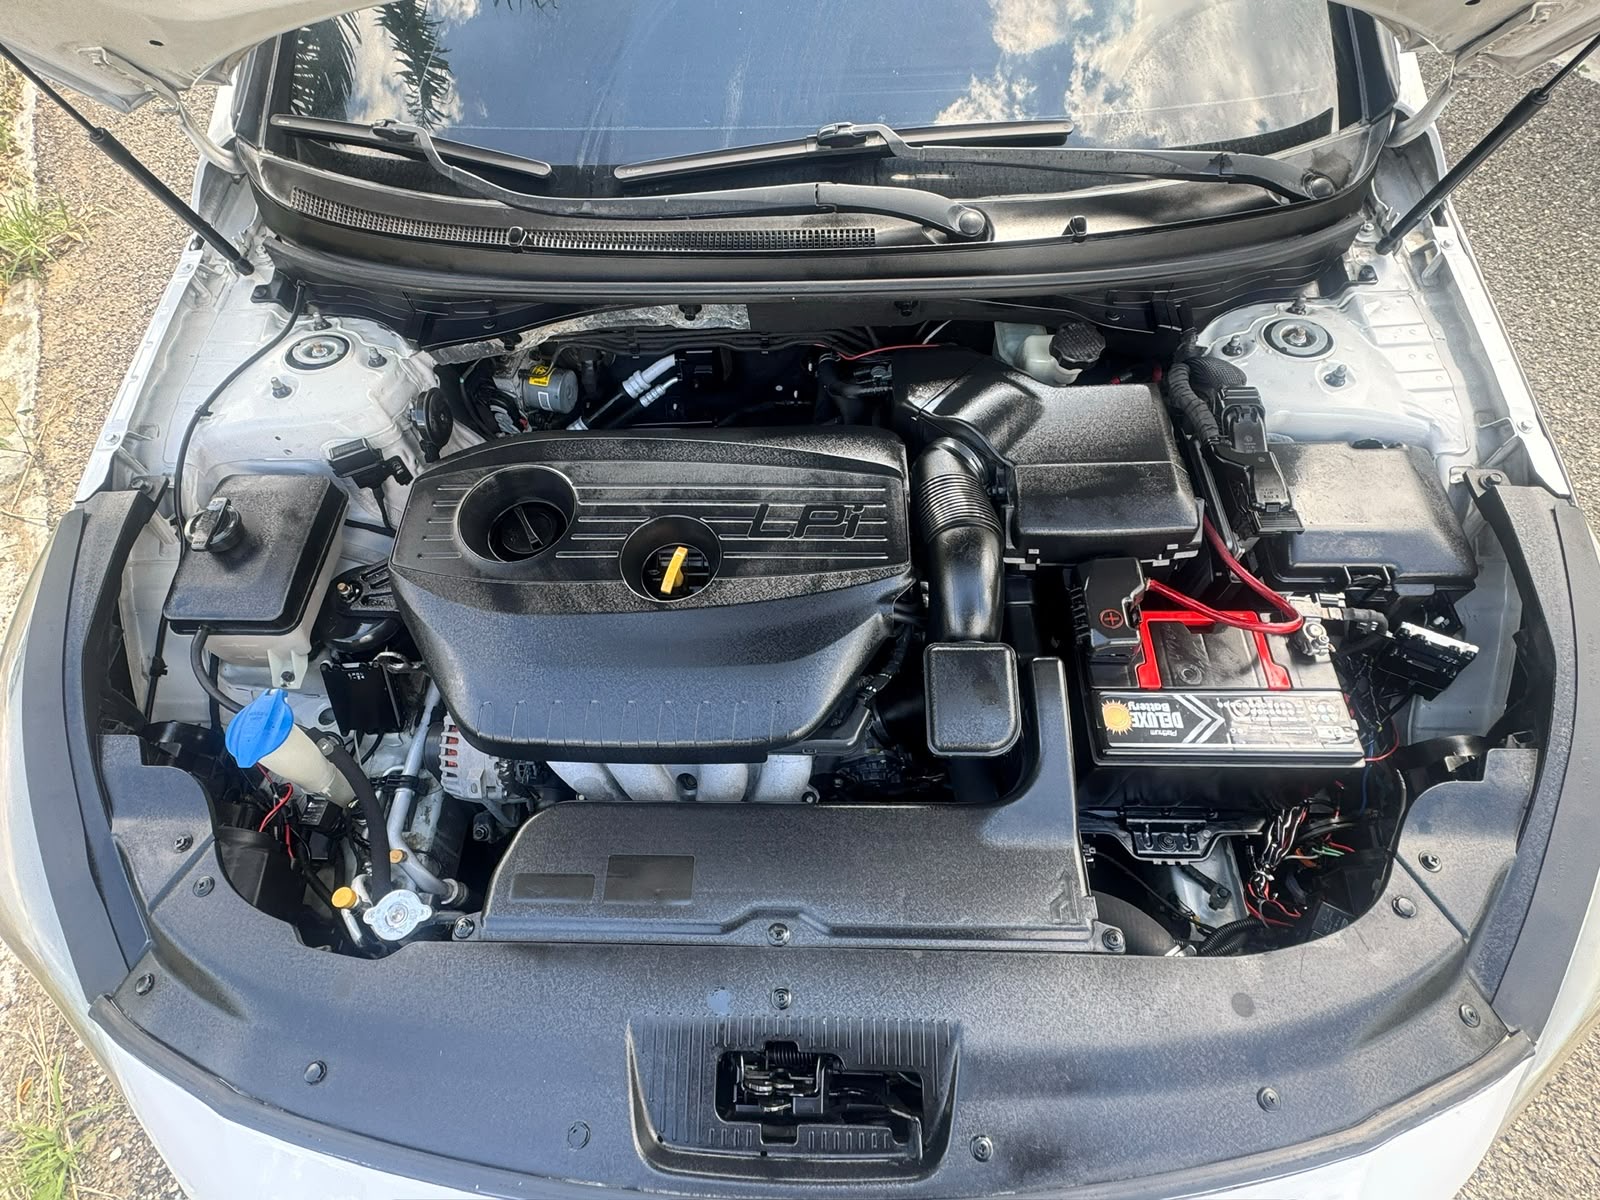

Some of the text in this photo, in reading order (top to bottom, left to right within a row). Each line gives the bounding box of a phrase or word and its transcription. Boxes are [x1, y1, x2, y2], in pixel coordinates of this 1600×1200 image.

[747, 503, 865, 539] LPi
[1128, 701, 1170, 712] Battery
[1129, 711, 1184, 729] DELUXE
[1150, 729, 1178, 737] Platinum
